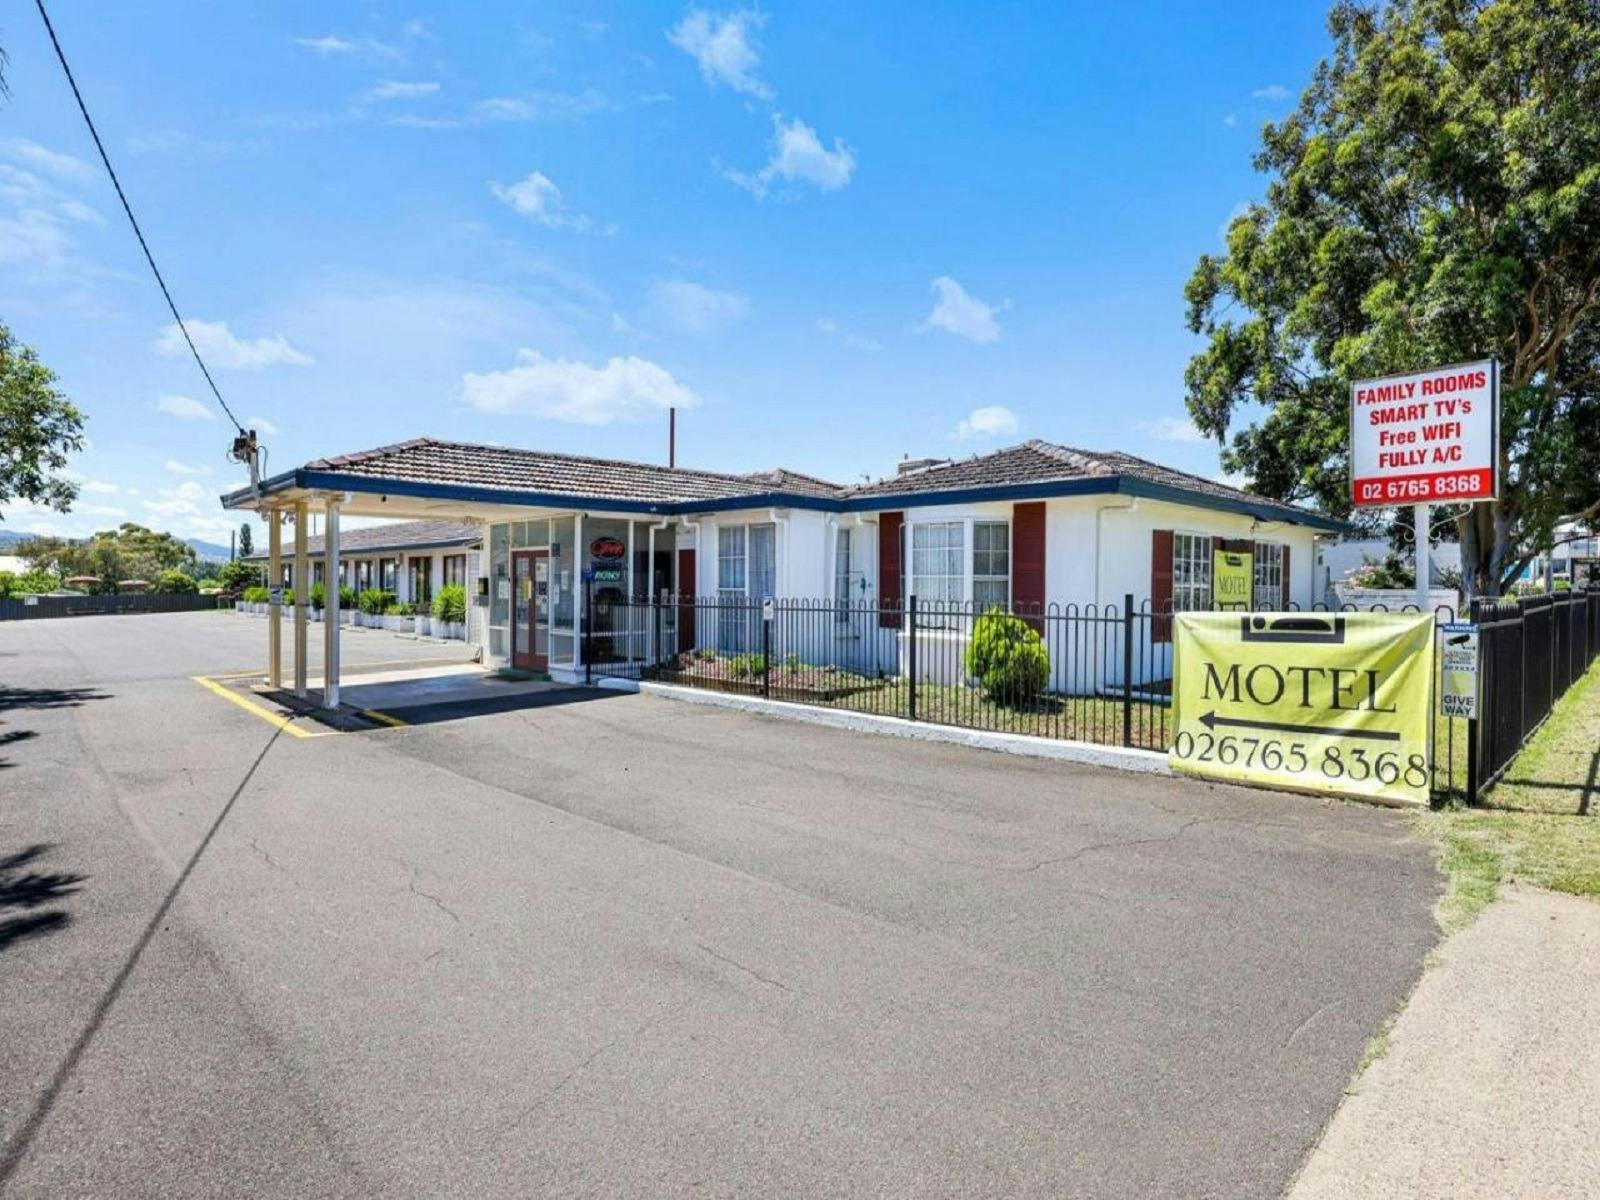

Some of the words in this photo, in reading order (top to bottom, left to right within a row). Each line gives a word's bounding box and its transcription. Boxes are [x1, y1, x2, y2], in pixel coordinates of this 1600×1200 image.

[1357, 383, 1416, 405] FAMILY
[1422, 371, 1486, 396] ROOMS
[1369, 403, 1428, 426] SMART
[1434, 399, 1472, 417] TV's
[1379, 430, 1416, 446] Free
[1422, 422, 1461, 442] WIFI
[1379, 449, 1427, 468] FULLY
[1433, 445, 1462, 464] A/C
[1362, 483, 1382, 499] 02
[1387, 479, 1430, 498] 6765
[1435, 474, 1481, 495] 8368
[1218, 575, 1248, 595] MOTEL
[1200, 662, 1397, 713] MOTEL
[1443, 694, 1475, 706] GIVE
[1444, 705, 1472, 716] WAY
[1174, 731, 1308, 773] 026765
[1320, 746, 1428, 788] 8368
